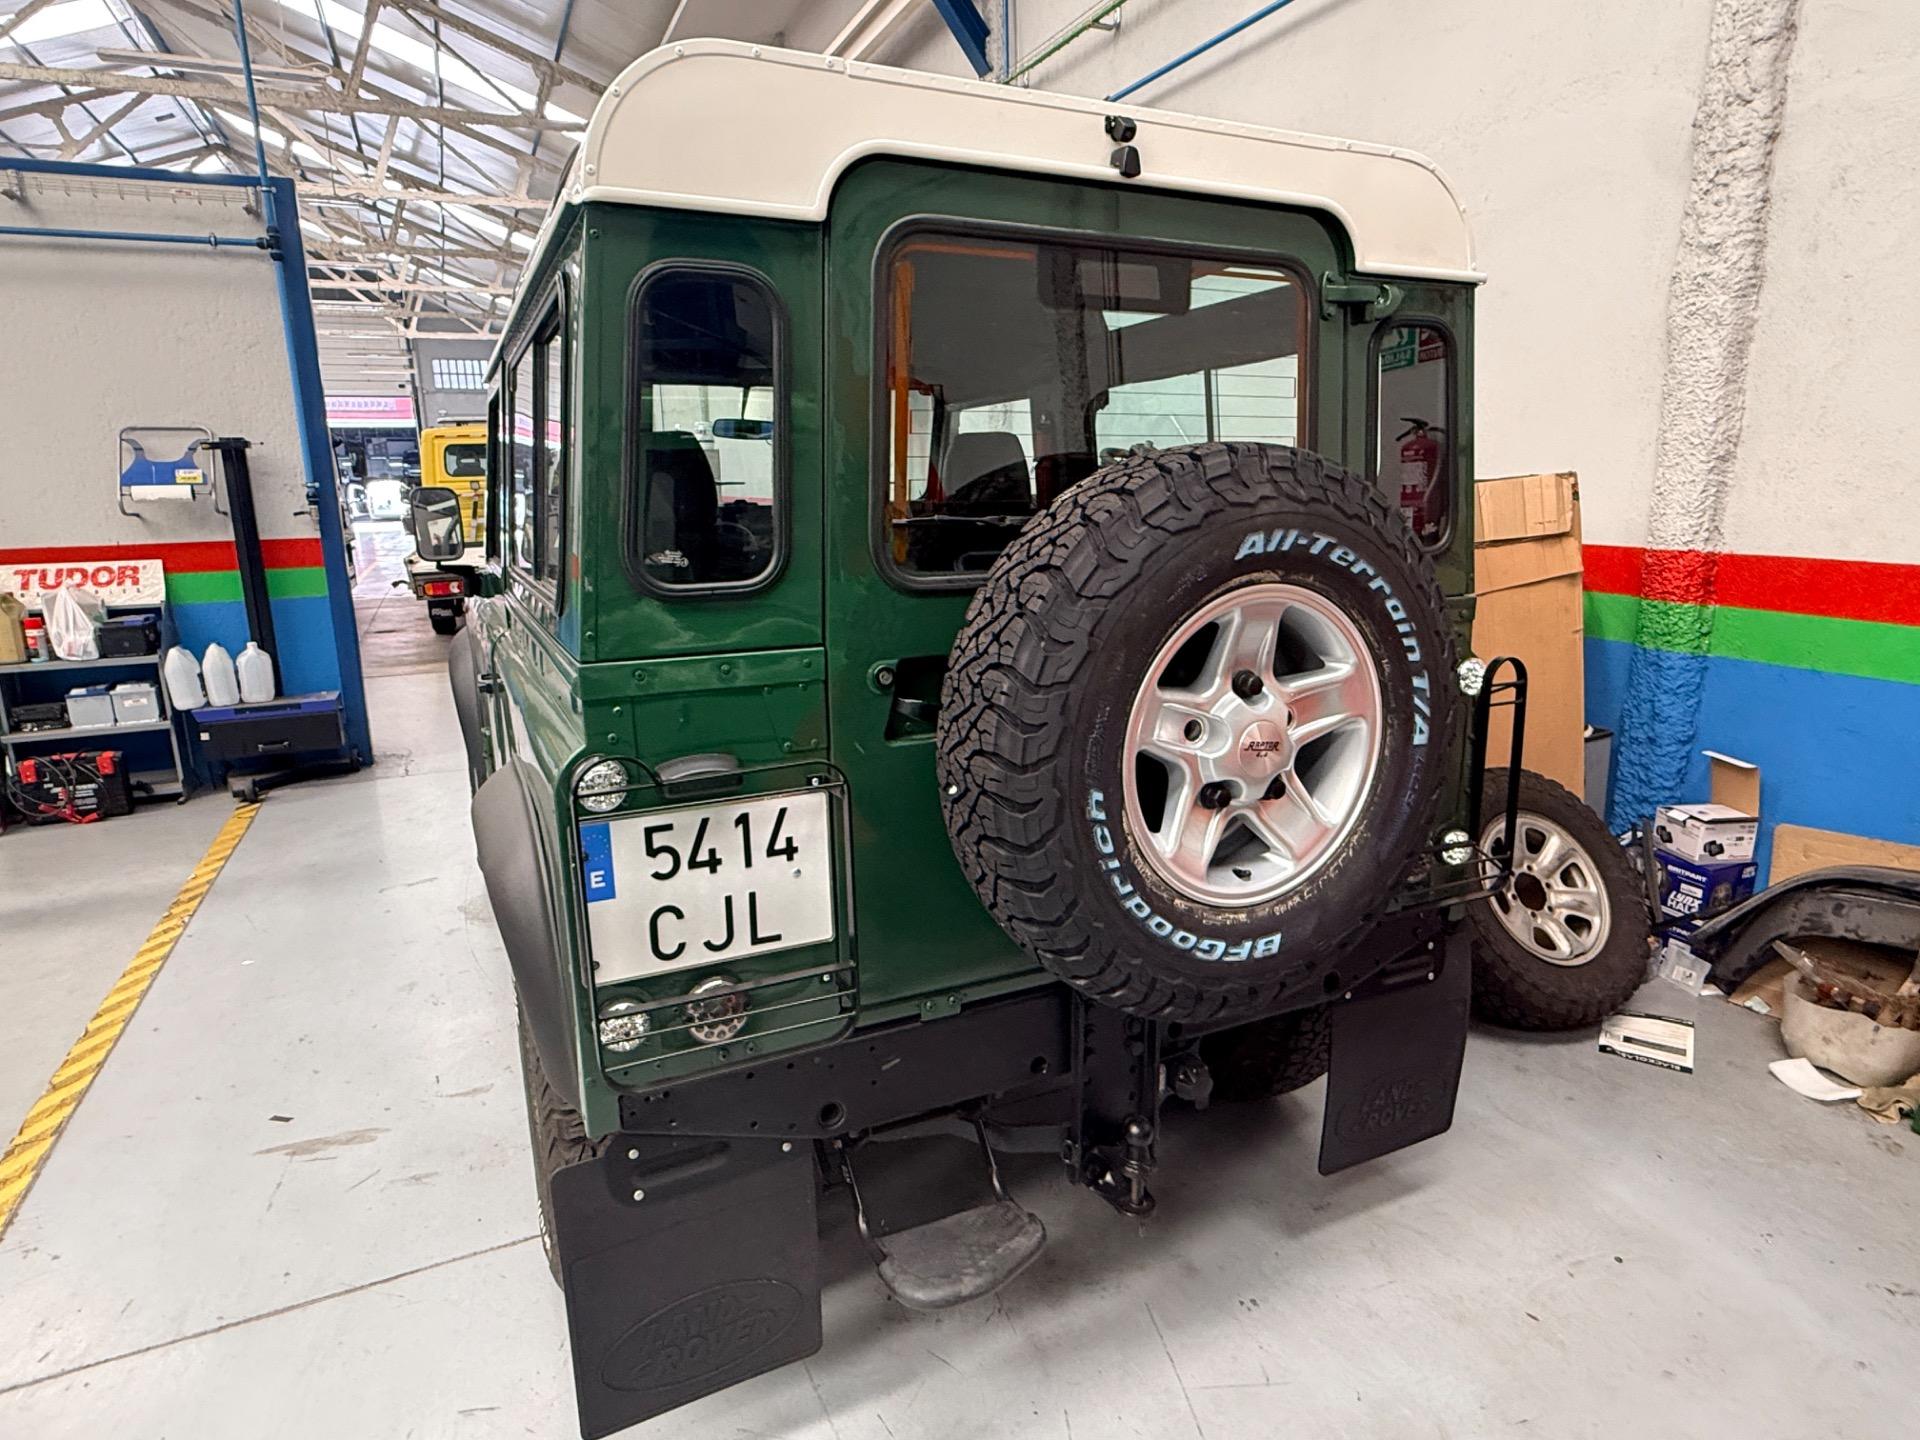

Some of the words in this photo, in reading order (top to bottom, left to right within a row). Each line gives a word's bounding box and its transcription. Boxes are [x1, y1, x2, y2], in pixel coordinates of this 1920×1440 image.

[13, 565, 140, 591] TUDOR
[1234, 528, 1421, 662] All-Terrain
[1412, 669, 1431, 745] T/A
[1244, 741, 1280, 751] RAPTOR
[644, 806, 799, 881] 5414
[590, 869, 606, 888] E
[1085, 787, 1282, 962] BFGoodrich
[1667, 864, 1708, 883] BRITPART
[649, 890, 782, 961] CJL
